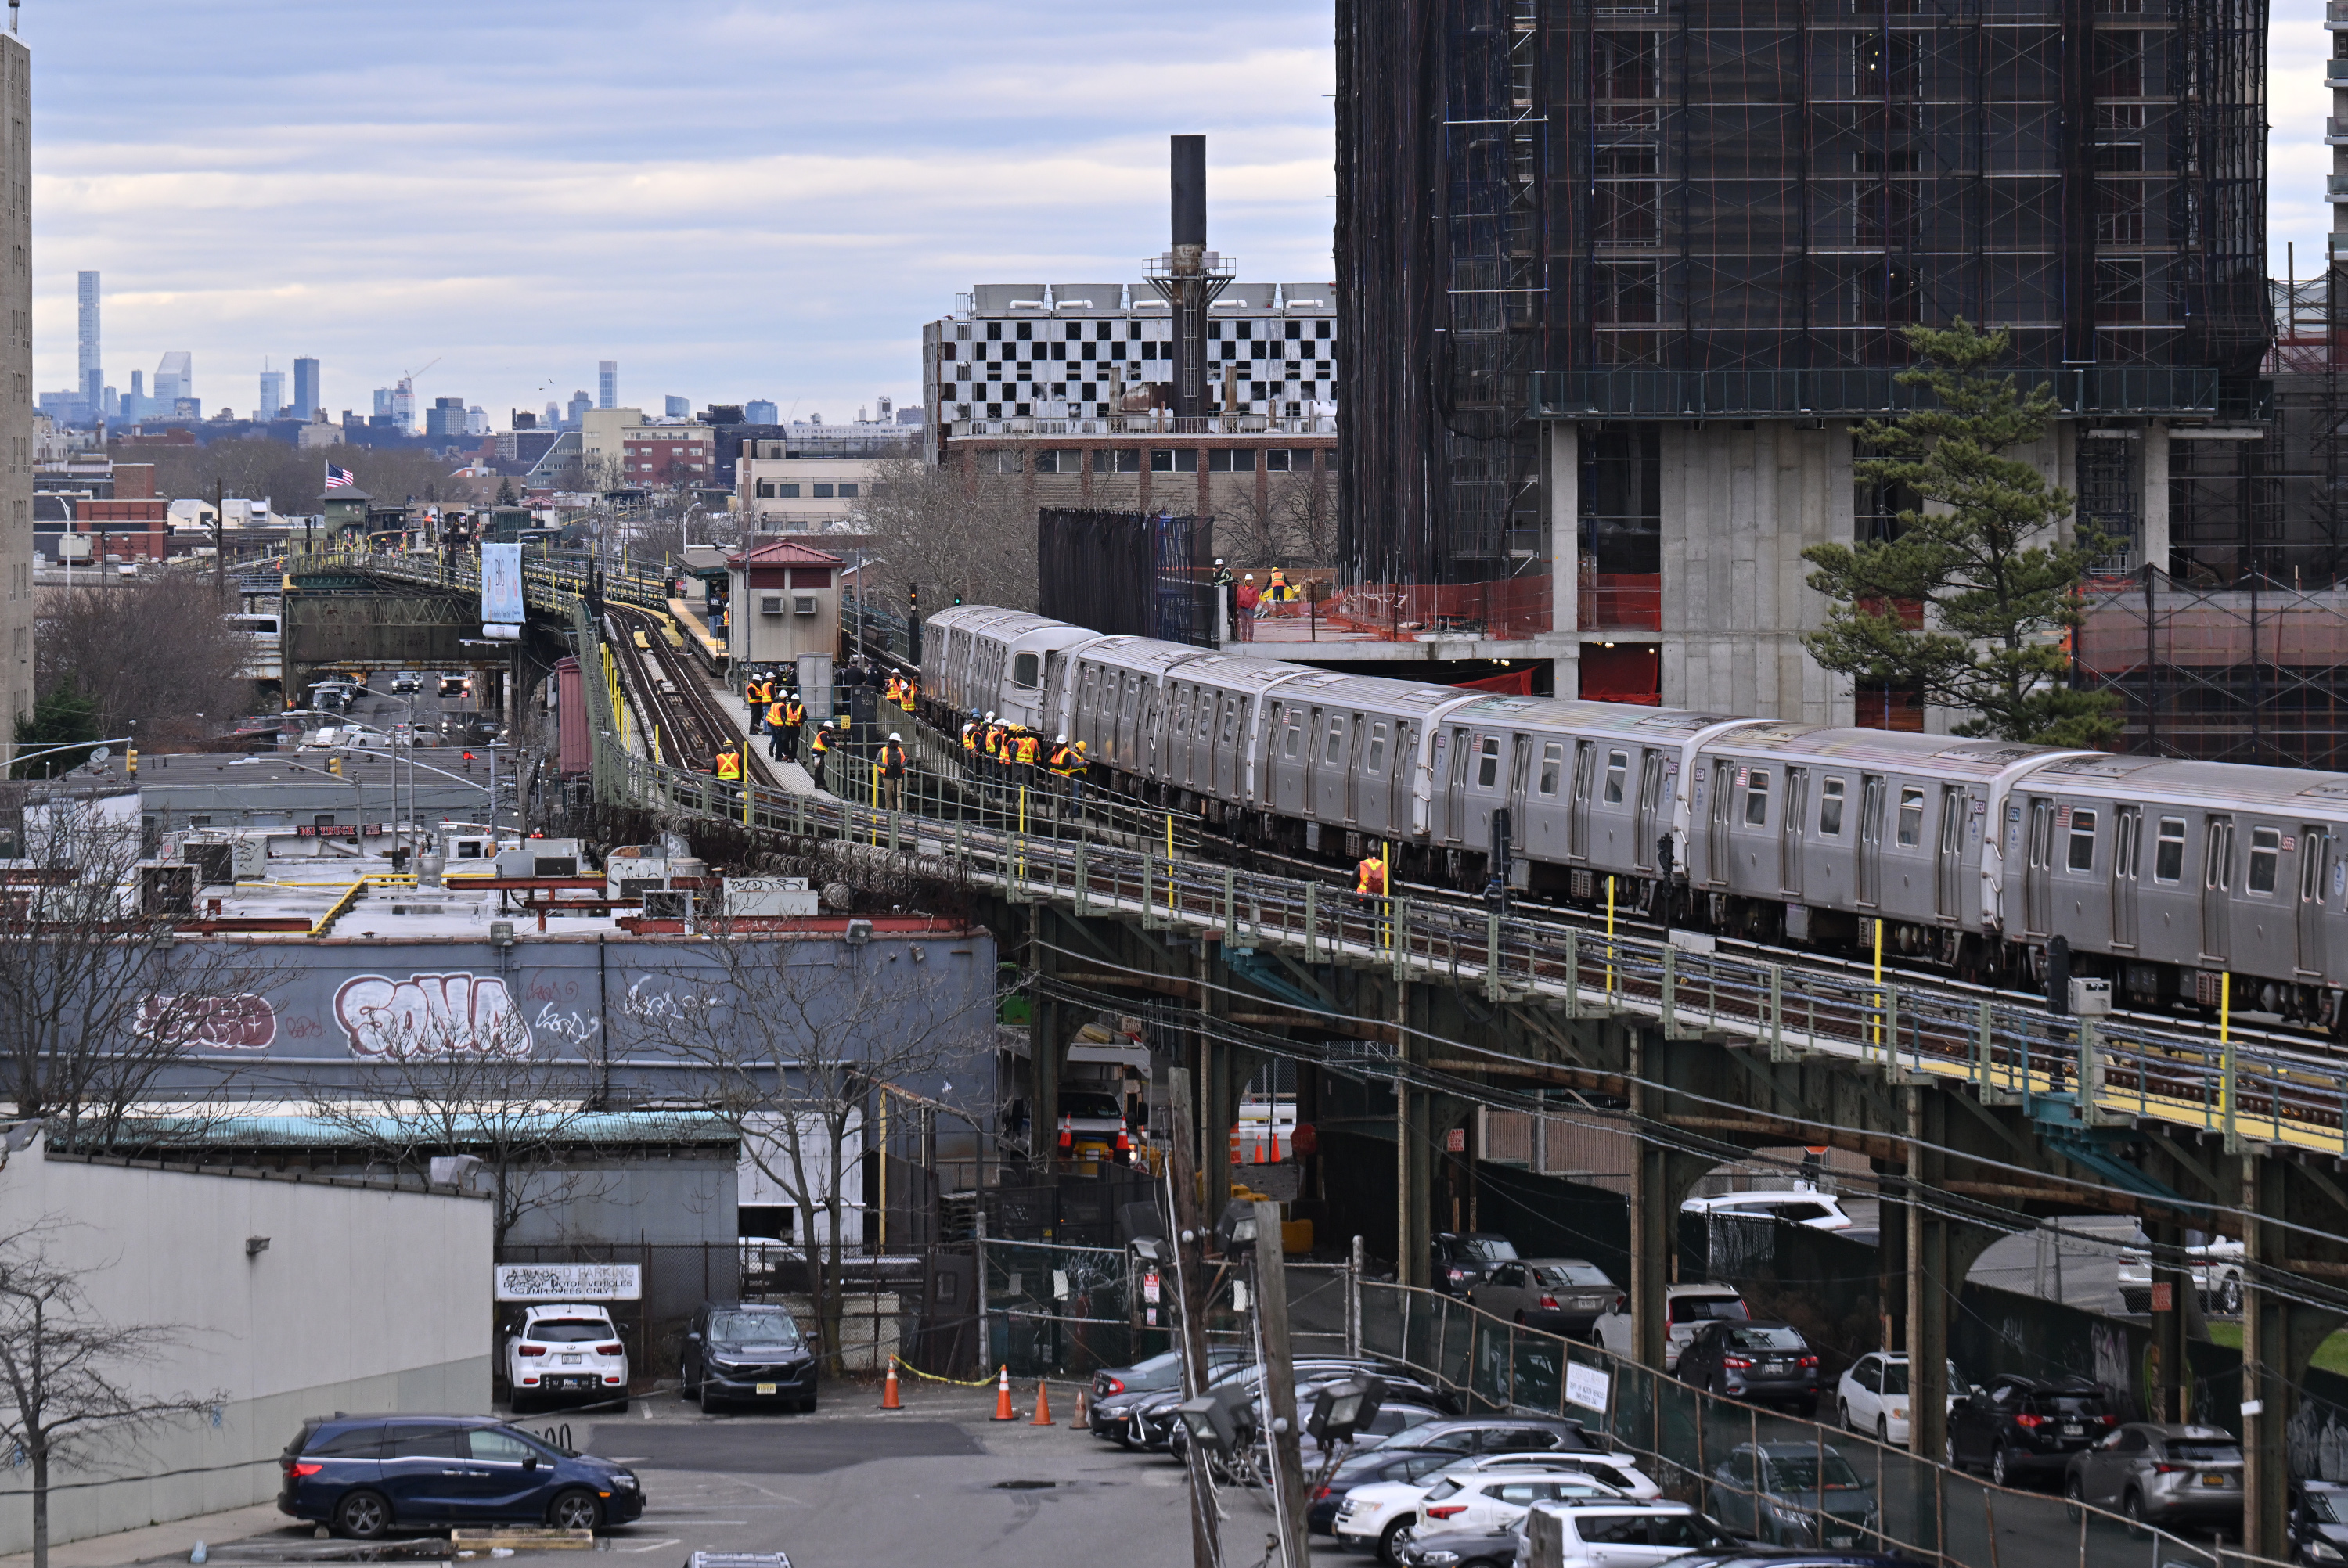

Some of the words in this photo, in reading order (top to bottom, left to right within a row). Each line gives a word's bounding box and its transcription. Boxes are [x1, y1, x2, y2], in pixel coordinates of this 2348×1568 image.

[300, 826, 315, 836] 161
[319, 825, 355, 836] TRUCK
[1292, 1132, 1316, 1147] STOP
[578, 1267, 634, 1278] PARKING
